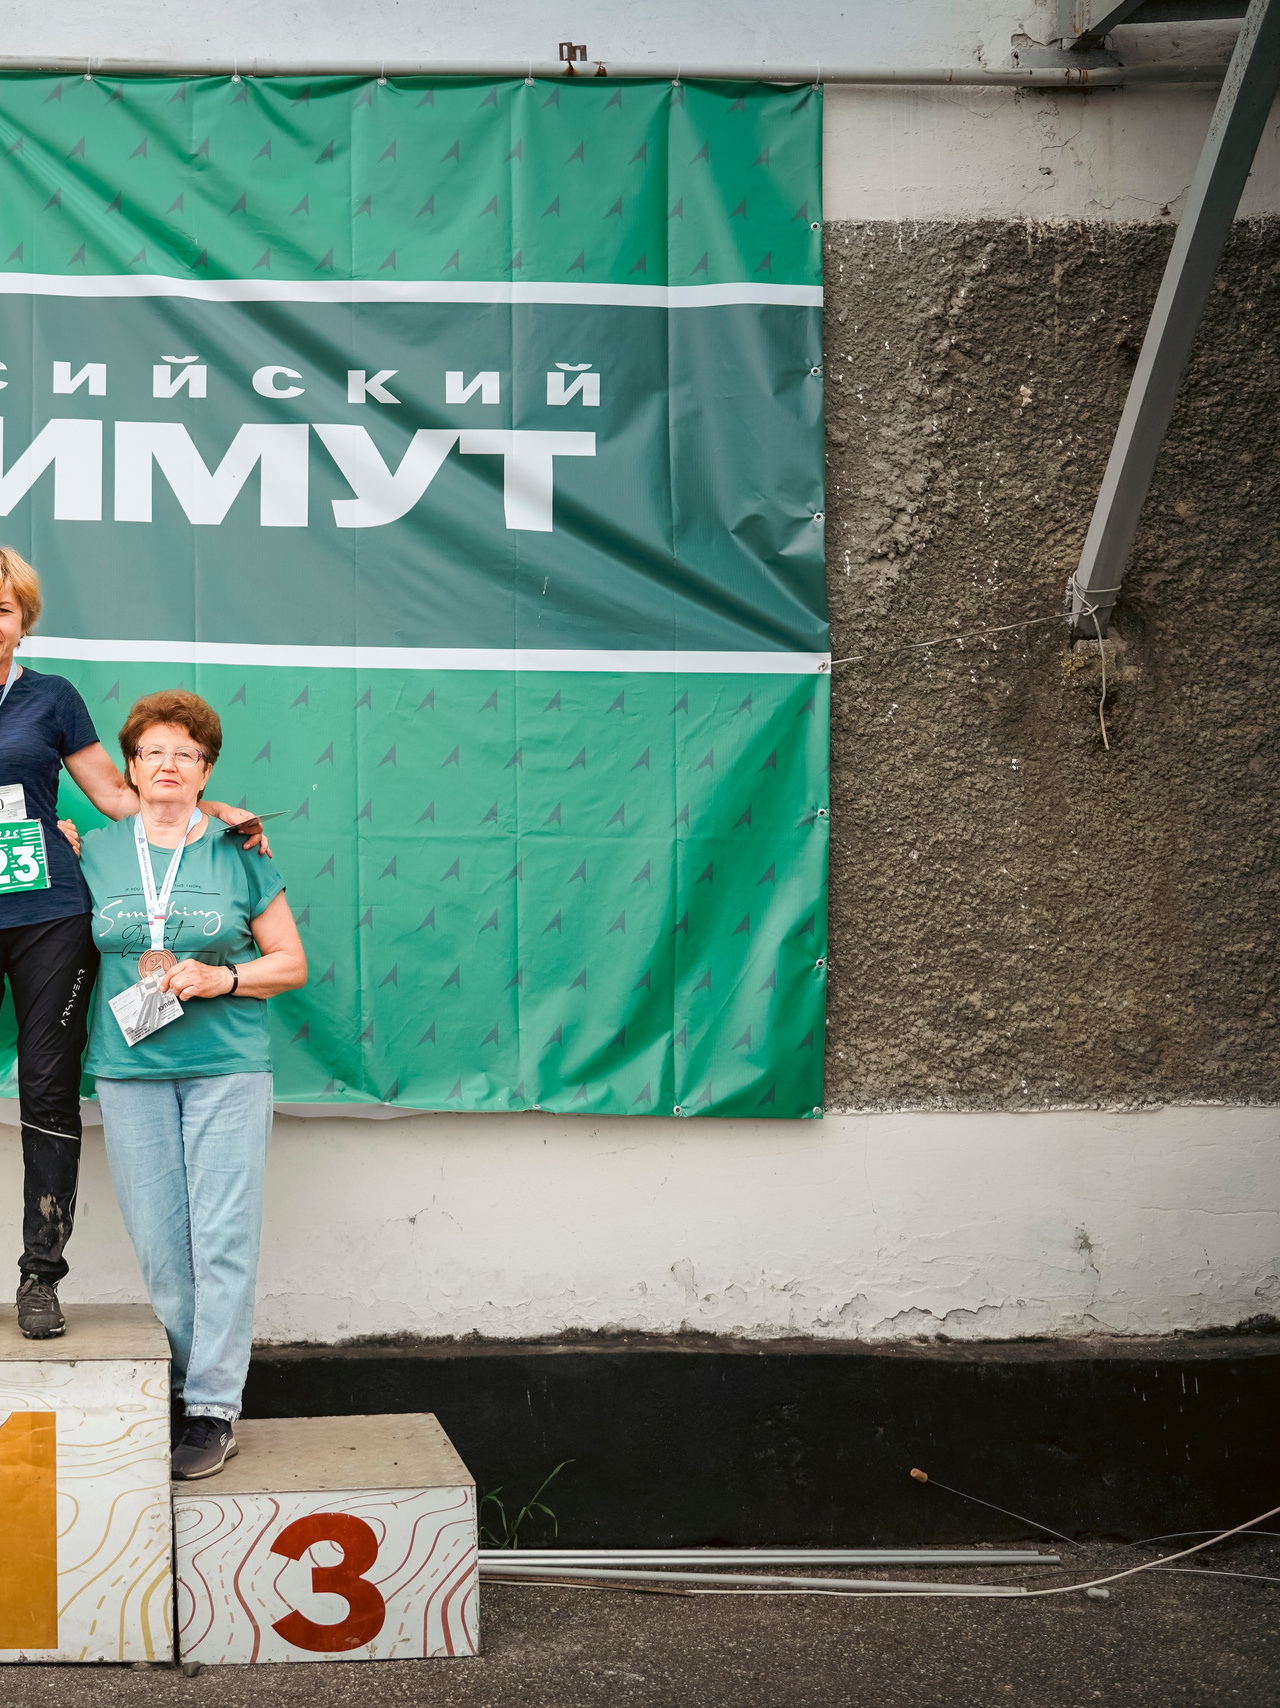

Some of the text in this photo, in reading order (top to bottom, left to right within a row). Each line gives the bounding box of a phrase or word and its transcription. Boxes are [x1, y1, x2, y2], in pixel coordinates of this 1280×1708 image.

[99, 900, 224, 937] Somhing
[122, 920, 195, 957] grat
[268, 1511, 387, 1653] 3
